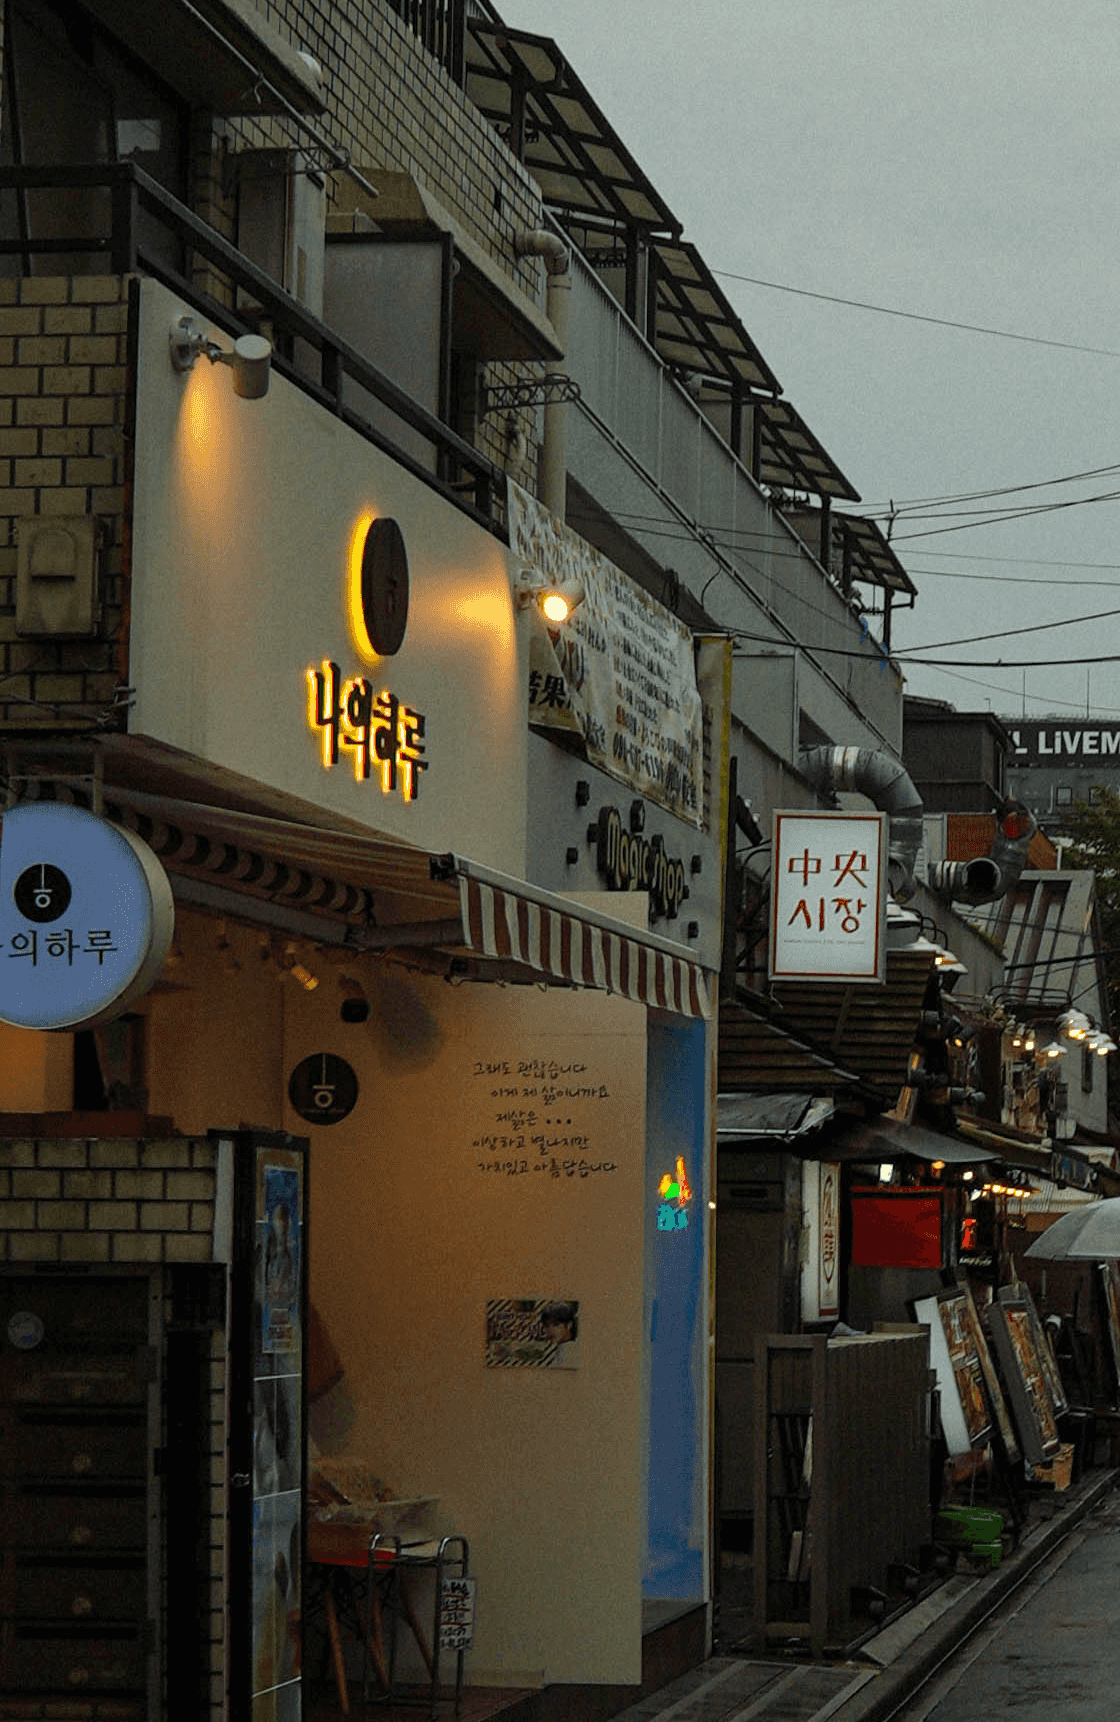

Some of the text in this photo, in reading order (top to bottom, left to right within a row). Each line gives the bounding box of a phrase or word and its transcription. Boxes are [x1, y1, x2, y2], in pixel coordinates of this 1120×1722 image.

[1008, 730, 1028, 755] L
[788, 848, 869, 888] 中央
[788, 896, 868, 934] 시장
[0, 928, 118, 966] 의하루
